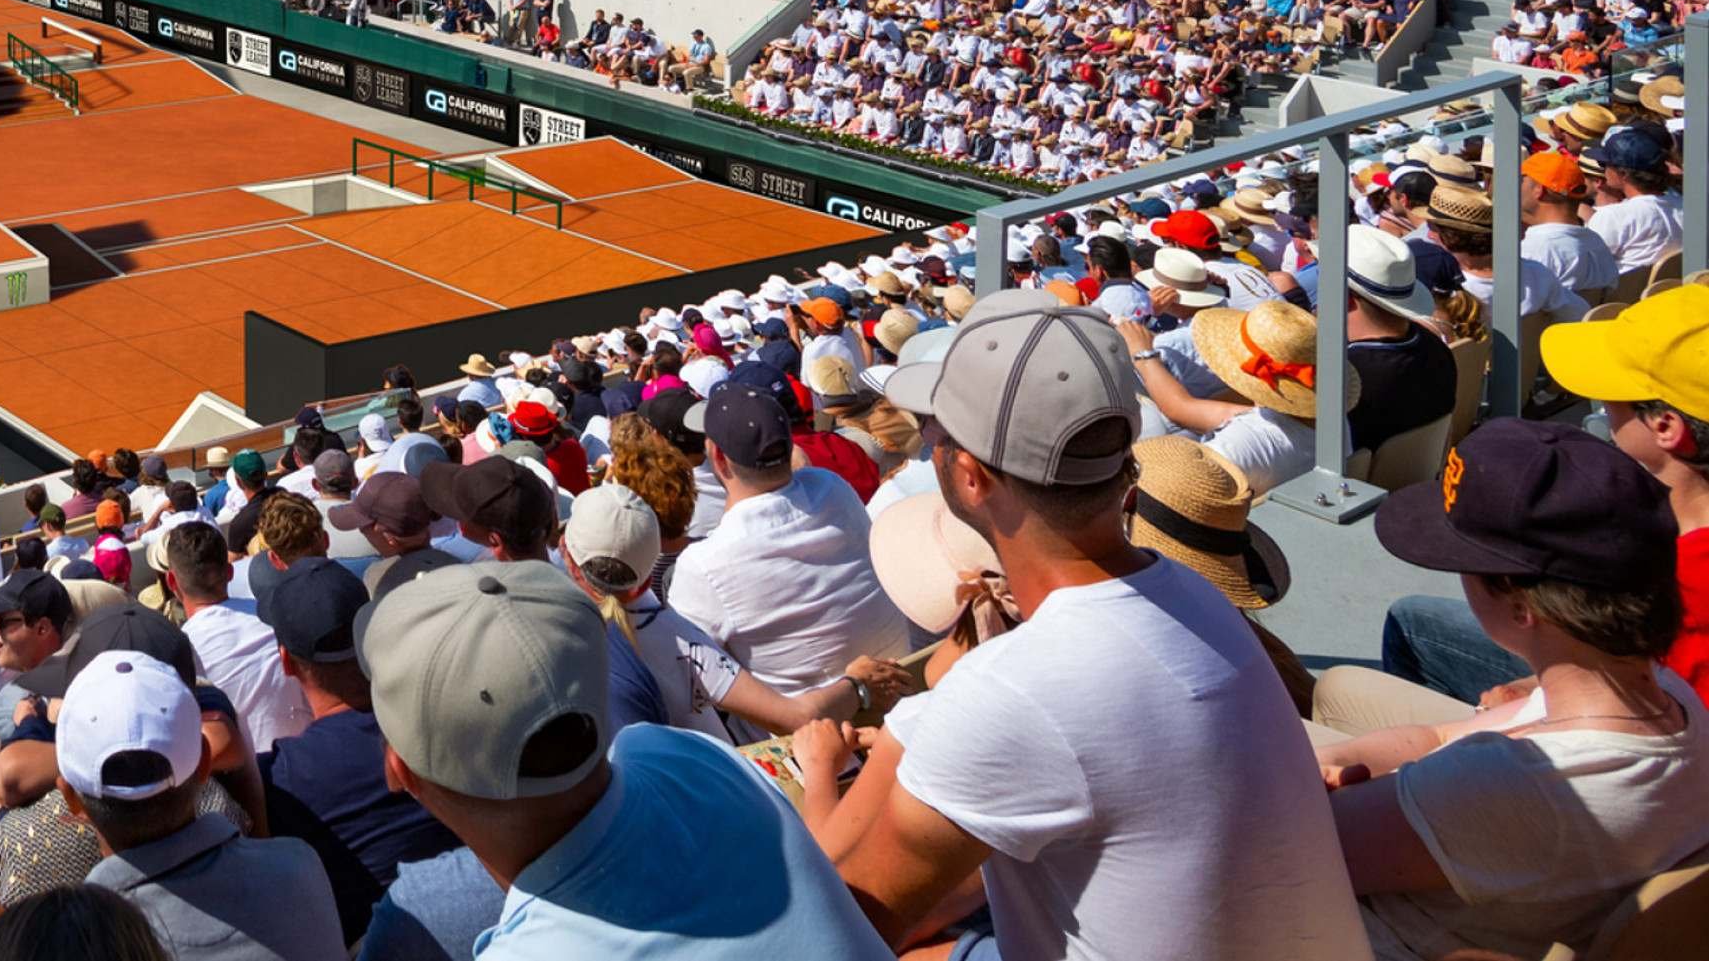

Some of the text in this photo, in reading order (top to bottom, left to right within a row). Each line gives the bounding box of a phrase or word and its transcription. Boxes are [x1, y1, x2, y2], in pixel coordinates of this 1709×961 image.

[174, 22, 214, 41] CALIFORNIA
[245, 37, 269, 53] STREET
[245, 49, 269, 67] LEAGUE
[297, 55, 345, 76] CALIFORNIA
[376, 71, 405, 90] STREET
[376, 86, 405, 106] LEAGUE
[448, 95, 506, 121] CALIFORNIA
[547, 116, 581, 137] STREET
[731, 166, 754, 186] SLS
[761, 172, 806, 199] STREET
